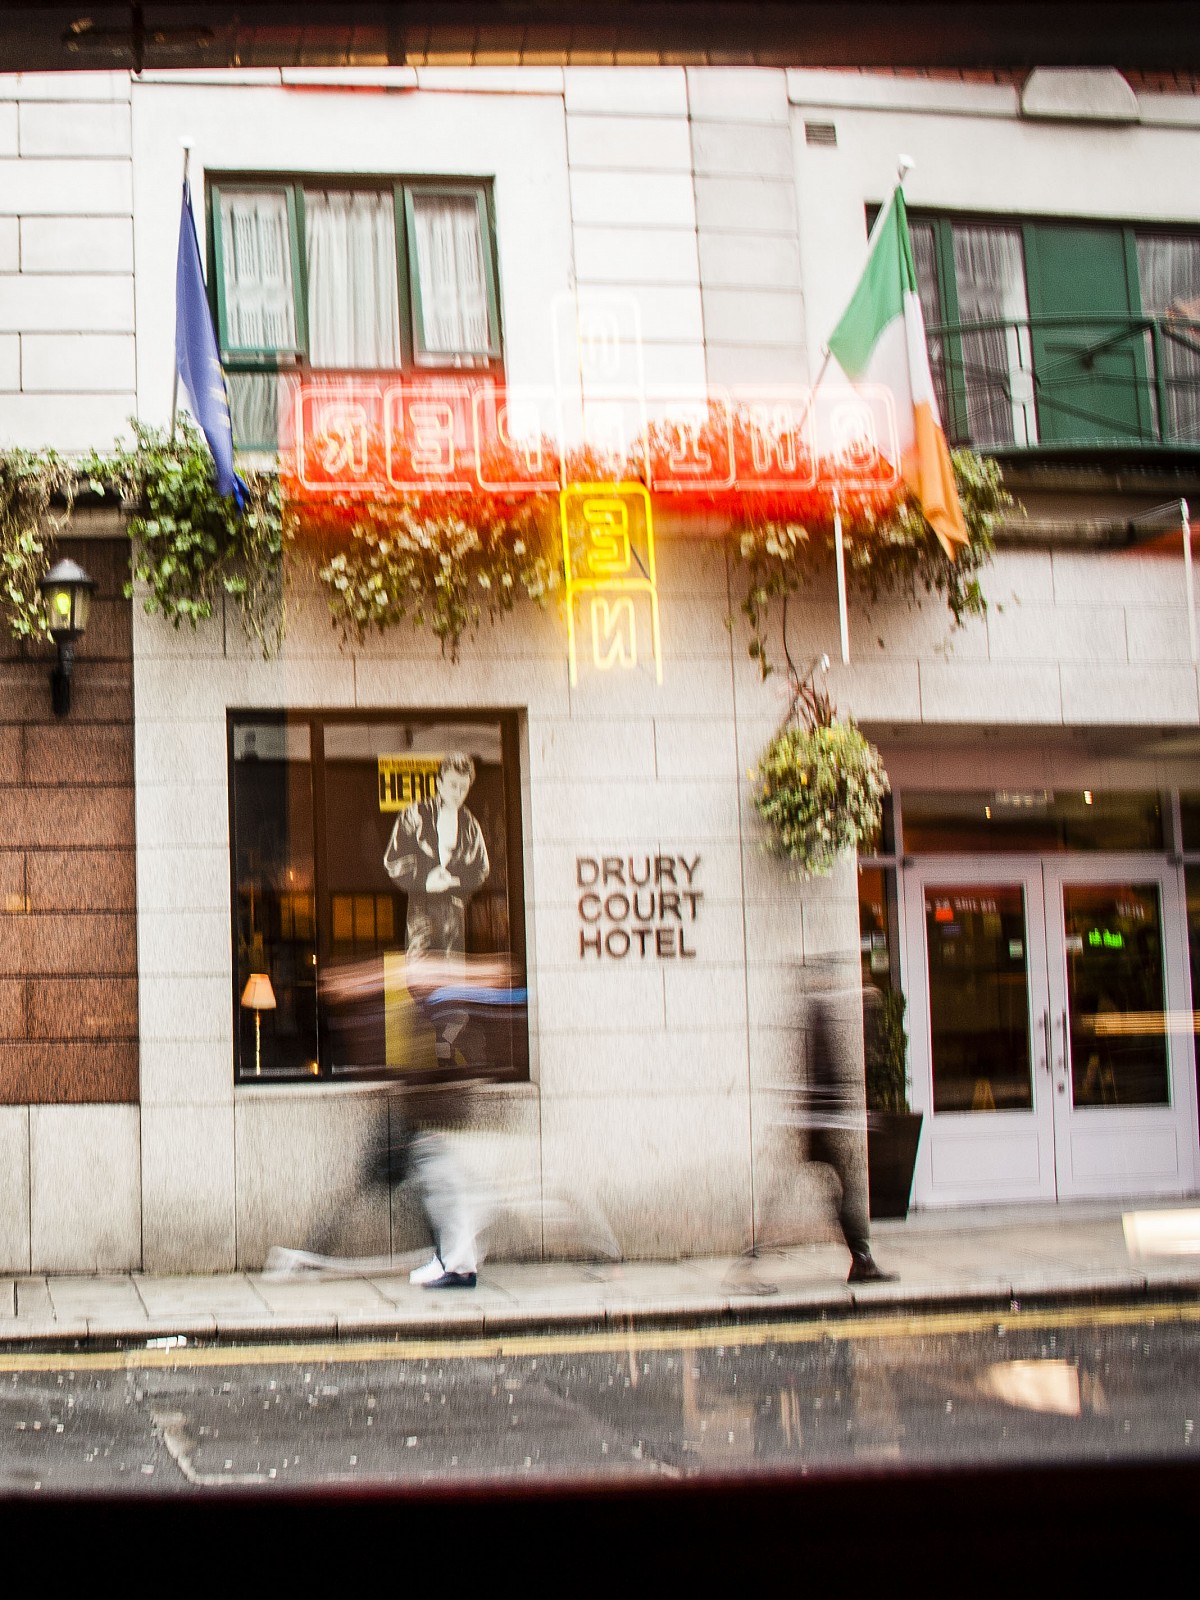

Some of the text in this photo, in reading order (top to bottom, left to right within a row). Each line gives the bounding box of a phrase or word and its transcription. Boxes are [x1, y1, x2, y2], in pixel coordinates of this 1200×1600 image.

[576, 856, 703, 888] DRURY
[577, 892, 704, 923] COURT
[579, 928, 697, 960] HOTEL
